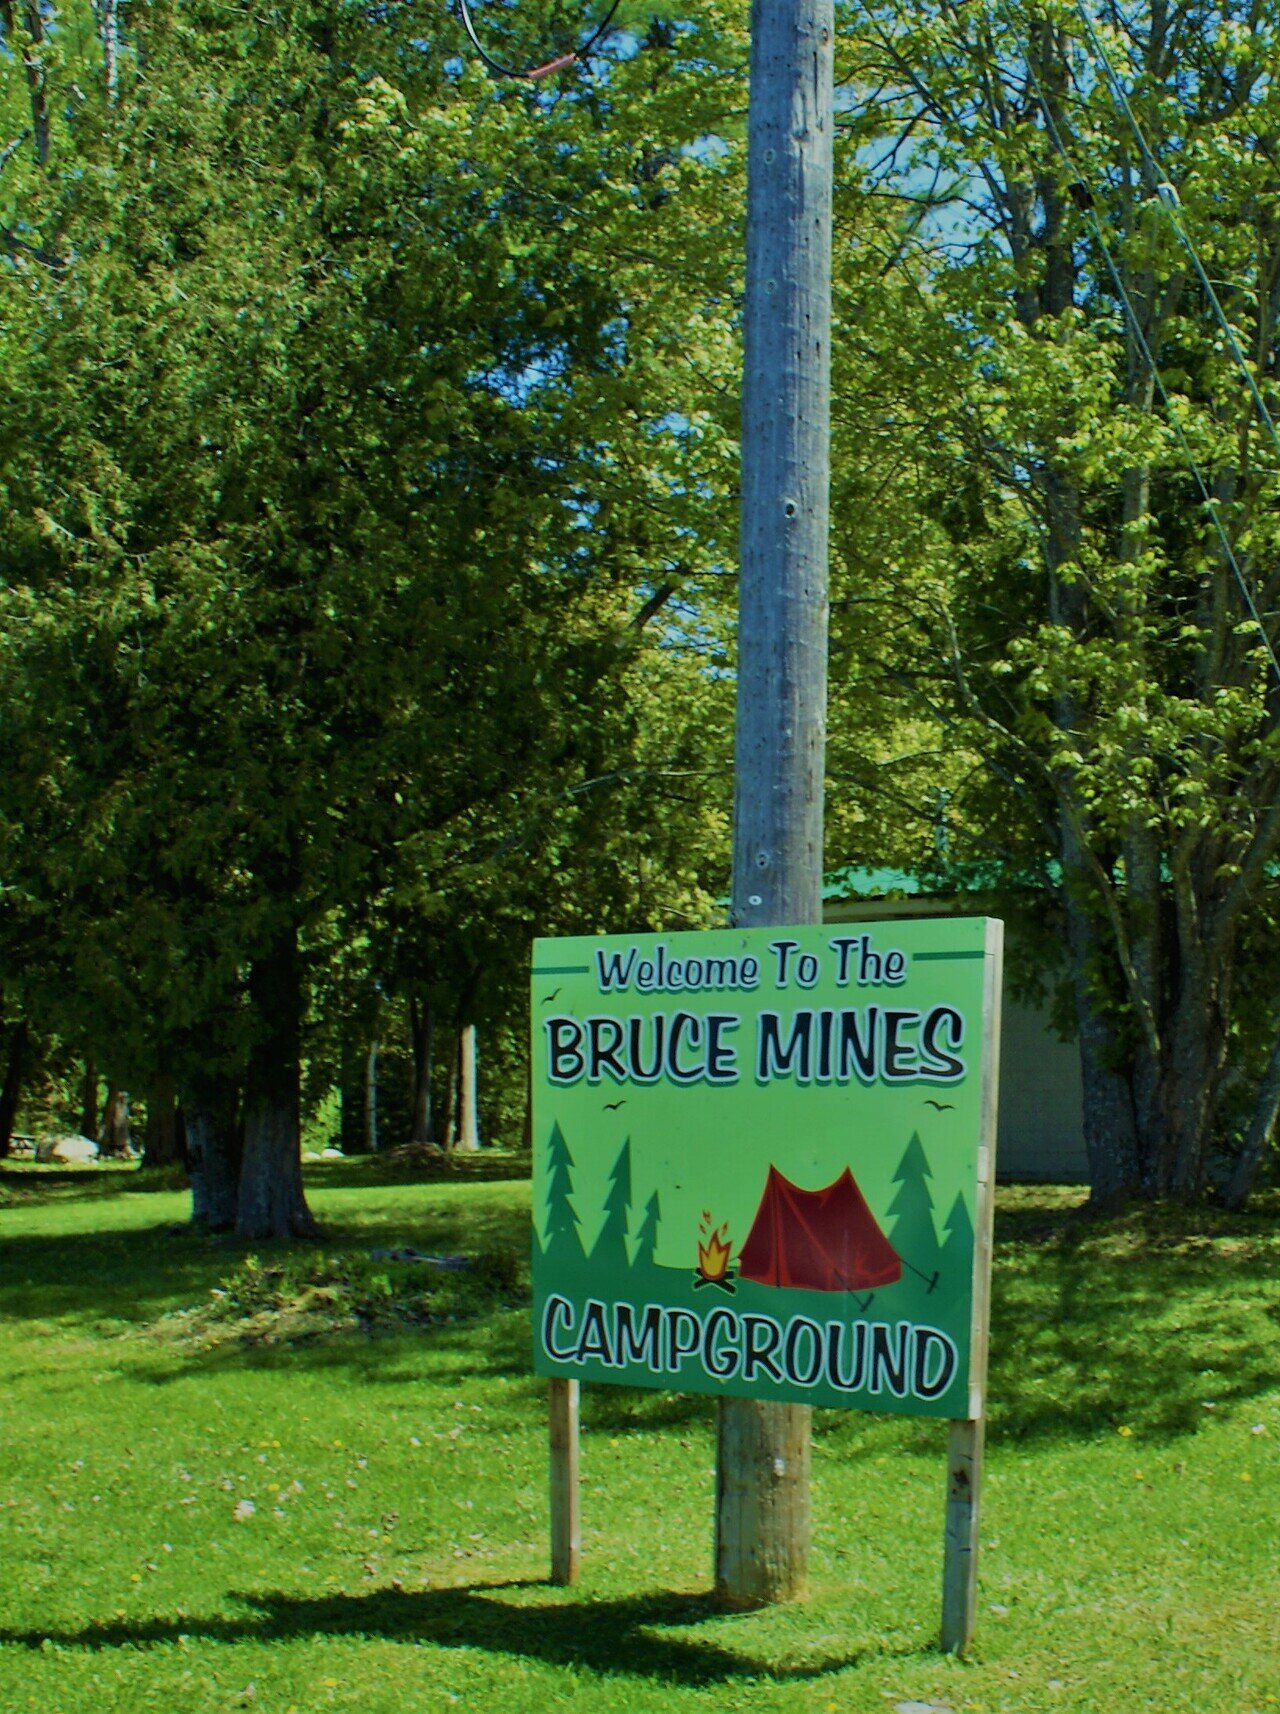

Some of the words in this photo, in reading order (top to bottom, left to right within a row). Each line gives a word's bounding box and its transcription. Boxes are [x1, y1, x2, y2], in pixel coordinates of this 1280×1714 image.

[596, 945, 758, 991] Welcome
[768, 941, 819, 986] To
[829, 935, 906, 984] The
[545, 1011, 741, 1083] BRUCE
[757, 1007, 966, 1081] MINES
[543, 1295, 957, 1400] CAMPGROUND
